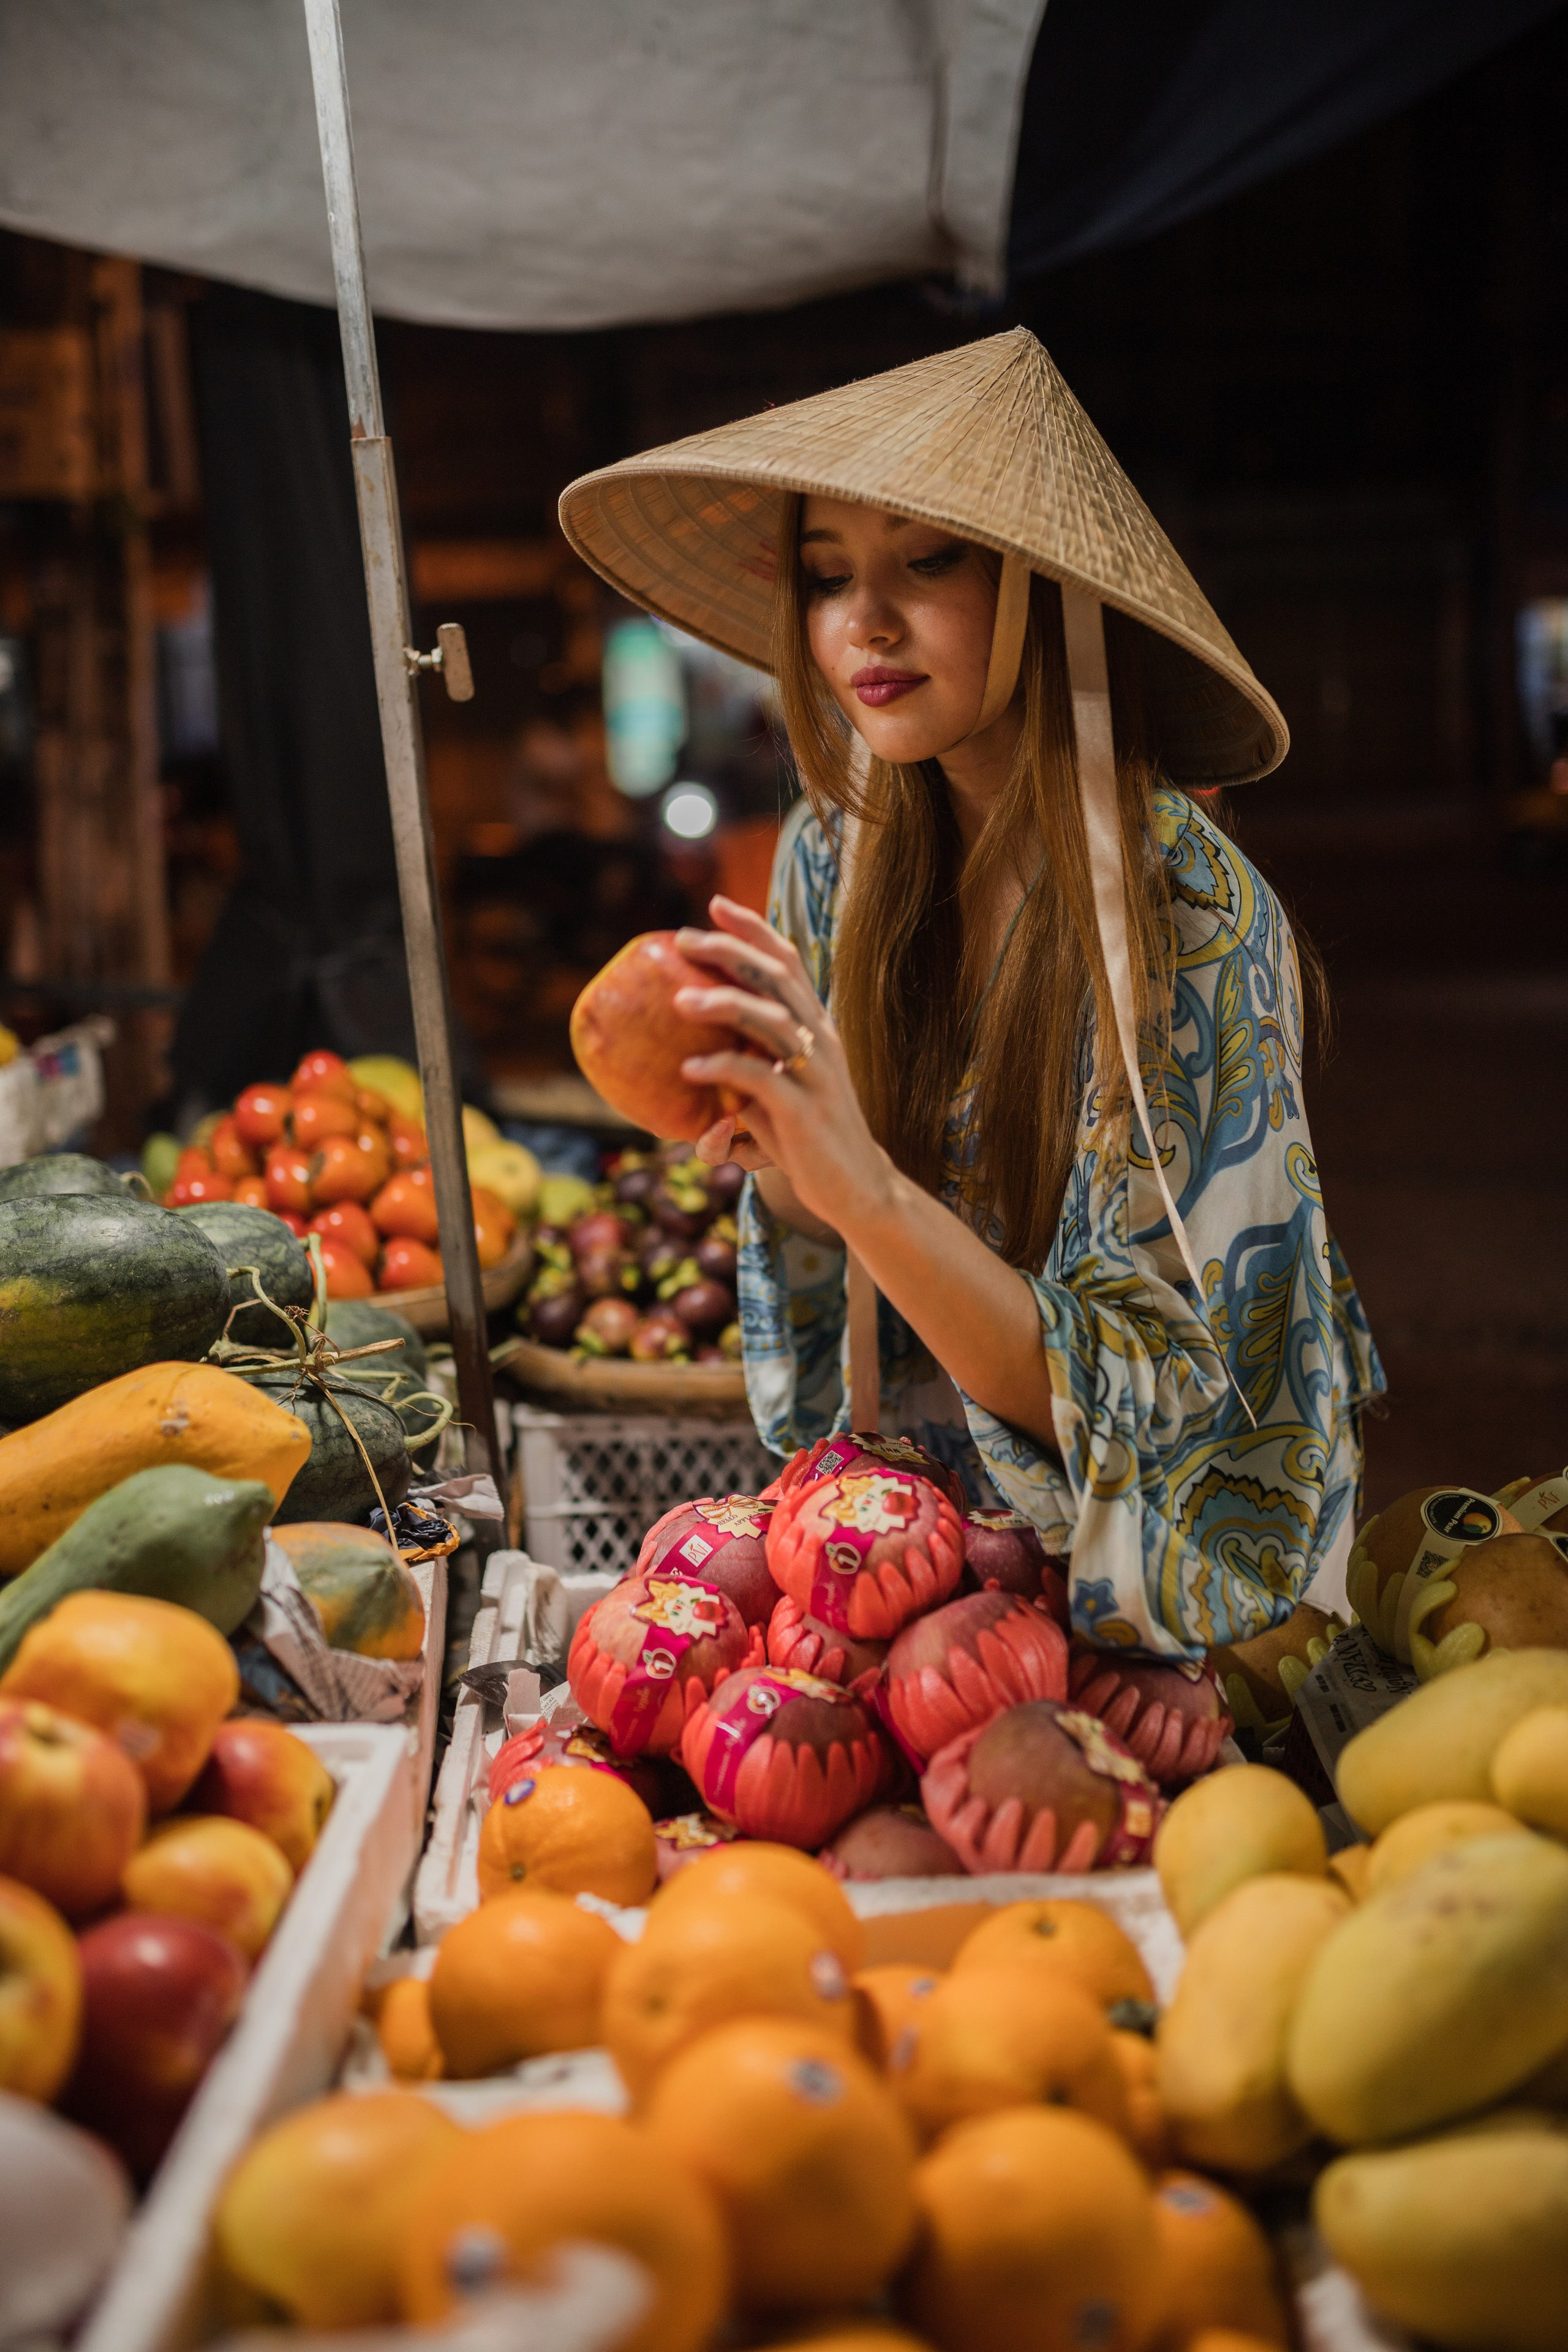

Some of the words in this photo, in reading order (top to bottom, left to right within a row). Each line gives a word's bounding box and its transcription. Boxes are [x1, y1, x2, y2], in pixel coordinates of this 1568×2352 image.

[1453, 1497, 1476, 1520] Premium
[717, 1514, 739, 1526] HELLO
[1444, 1518, 1459, 1534] Pear
[688, 1542, 709, 1564] PNF
